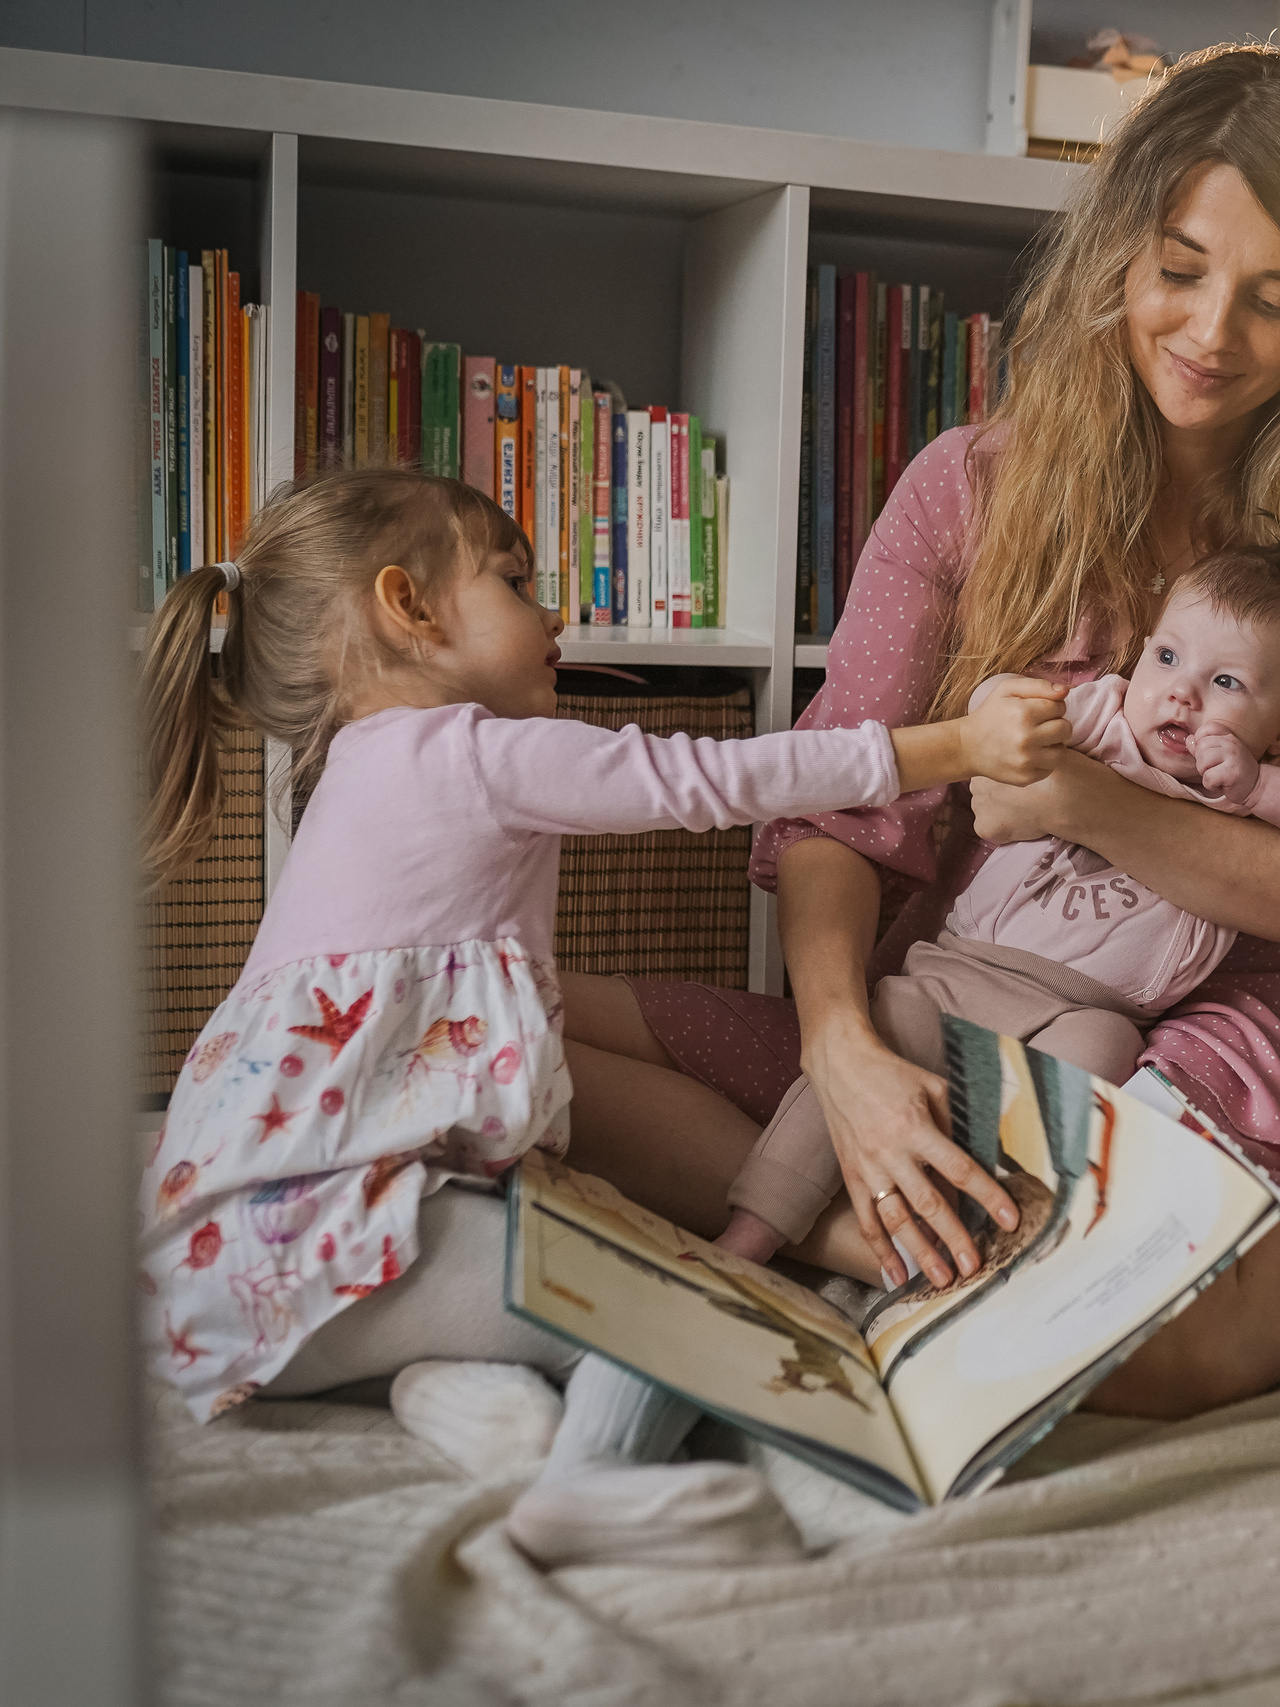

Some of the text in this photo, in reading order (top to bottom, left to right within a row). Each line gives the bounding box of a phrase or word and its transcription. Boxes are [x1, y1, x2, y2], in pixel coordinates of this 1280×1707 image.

[154, 466, 163, 496] ЛАМА
[504, 442, 513, 518] ая книга
